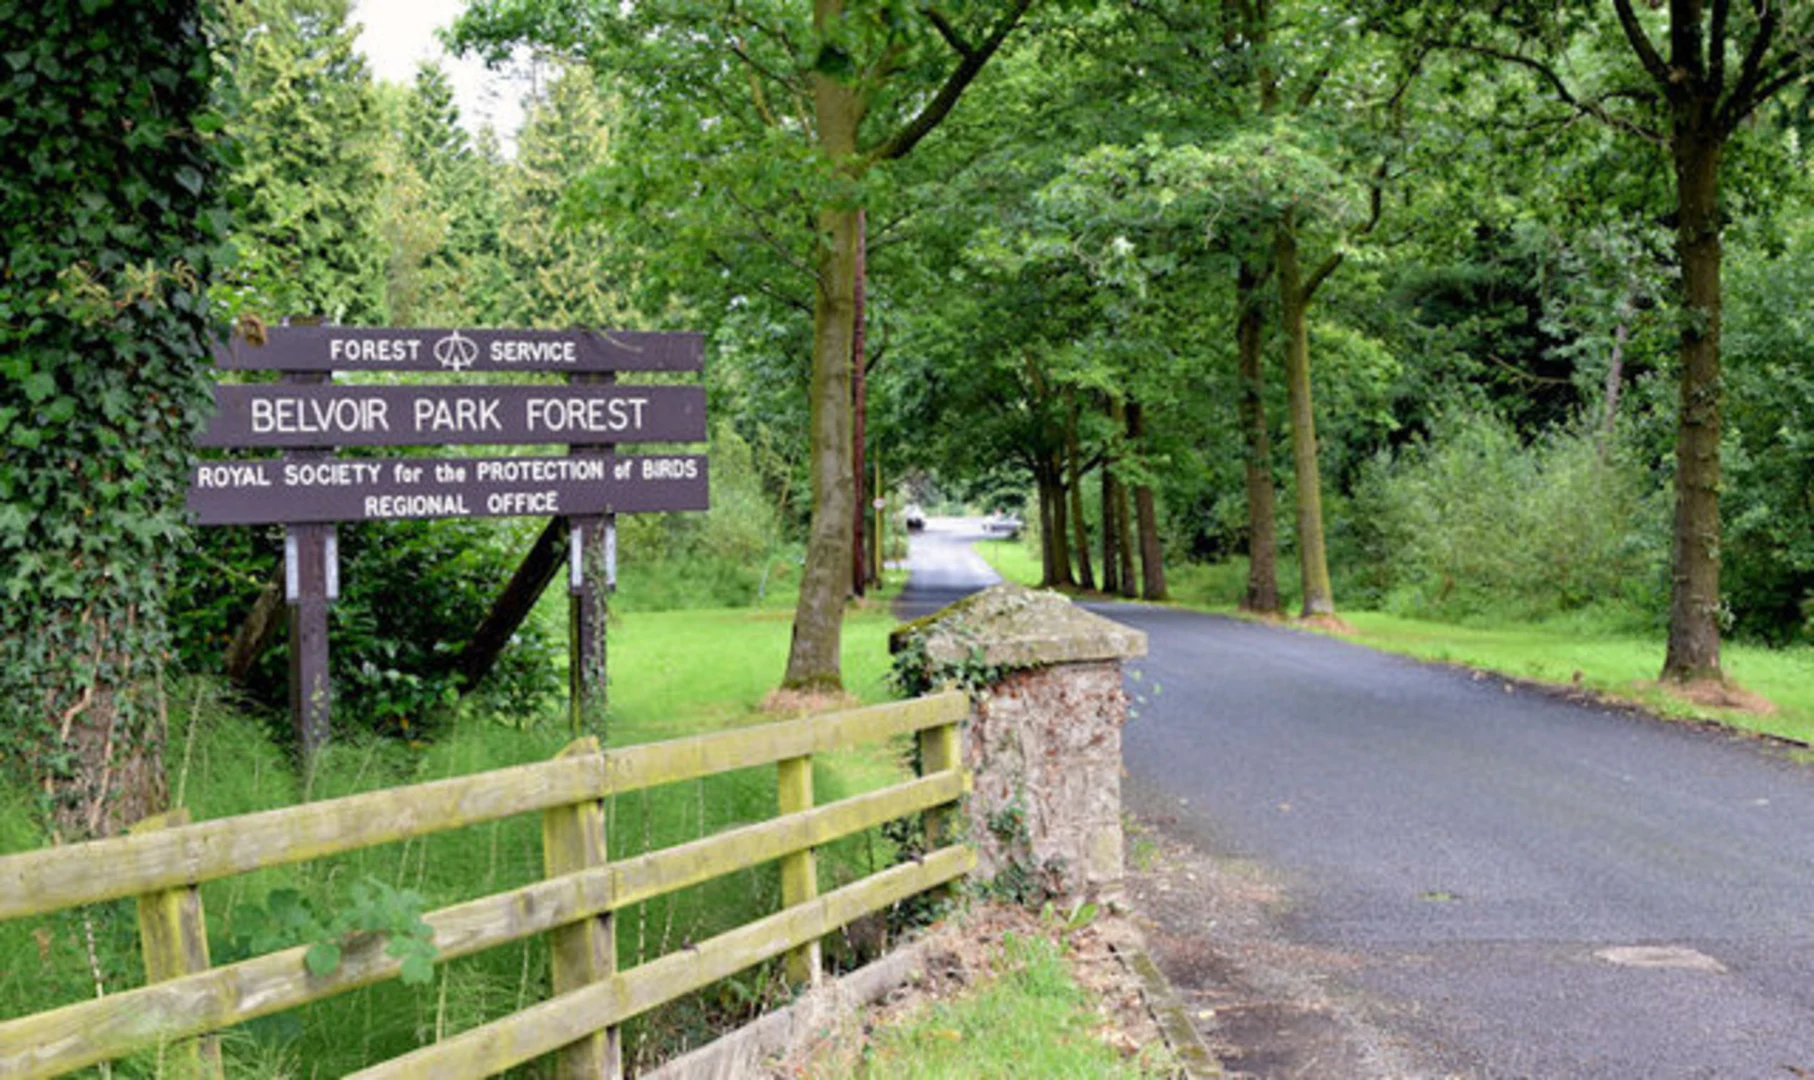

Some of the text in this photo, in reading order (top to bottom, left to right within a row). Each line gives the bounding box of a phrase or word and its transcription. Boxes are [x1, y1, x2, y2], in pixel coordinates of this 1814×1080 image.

[330, 339, 576, 362] FOREST SERVICE
[251, 398, 648, 433] BELVOIR PARK FOREST
[198, 458, 698, 488] ROYAL SOCIETY for the PROTECTION of BIRDS
[364, 491, 559, 517] REGIONAL OFFICE
